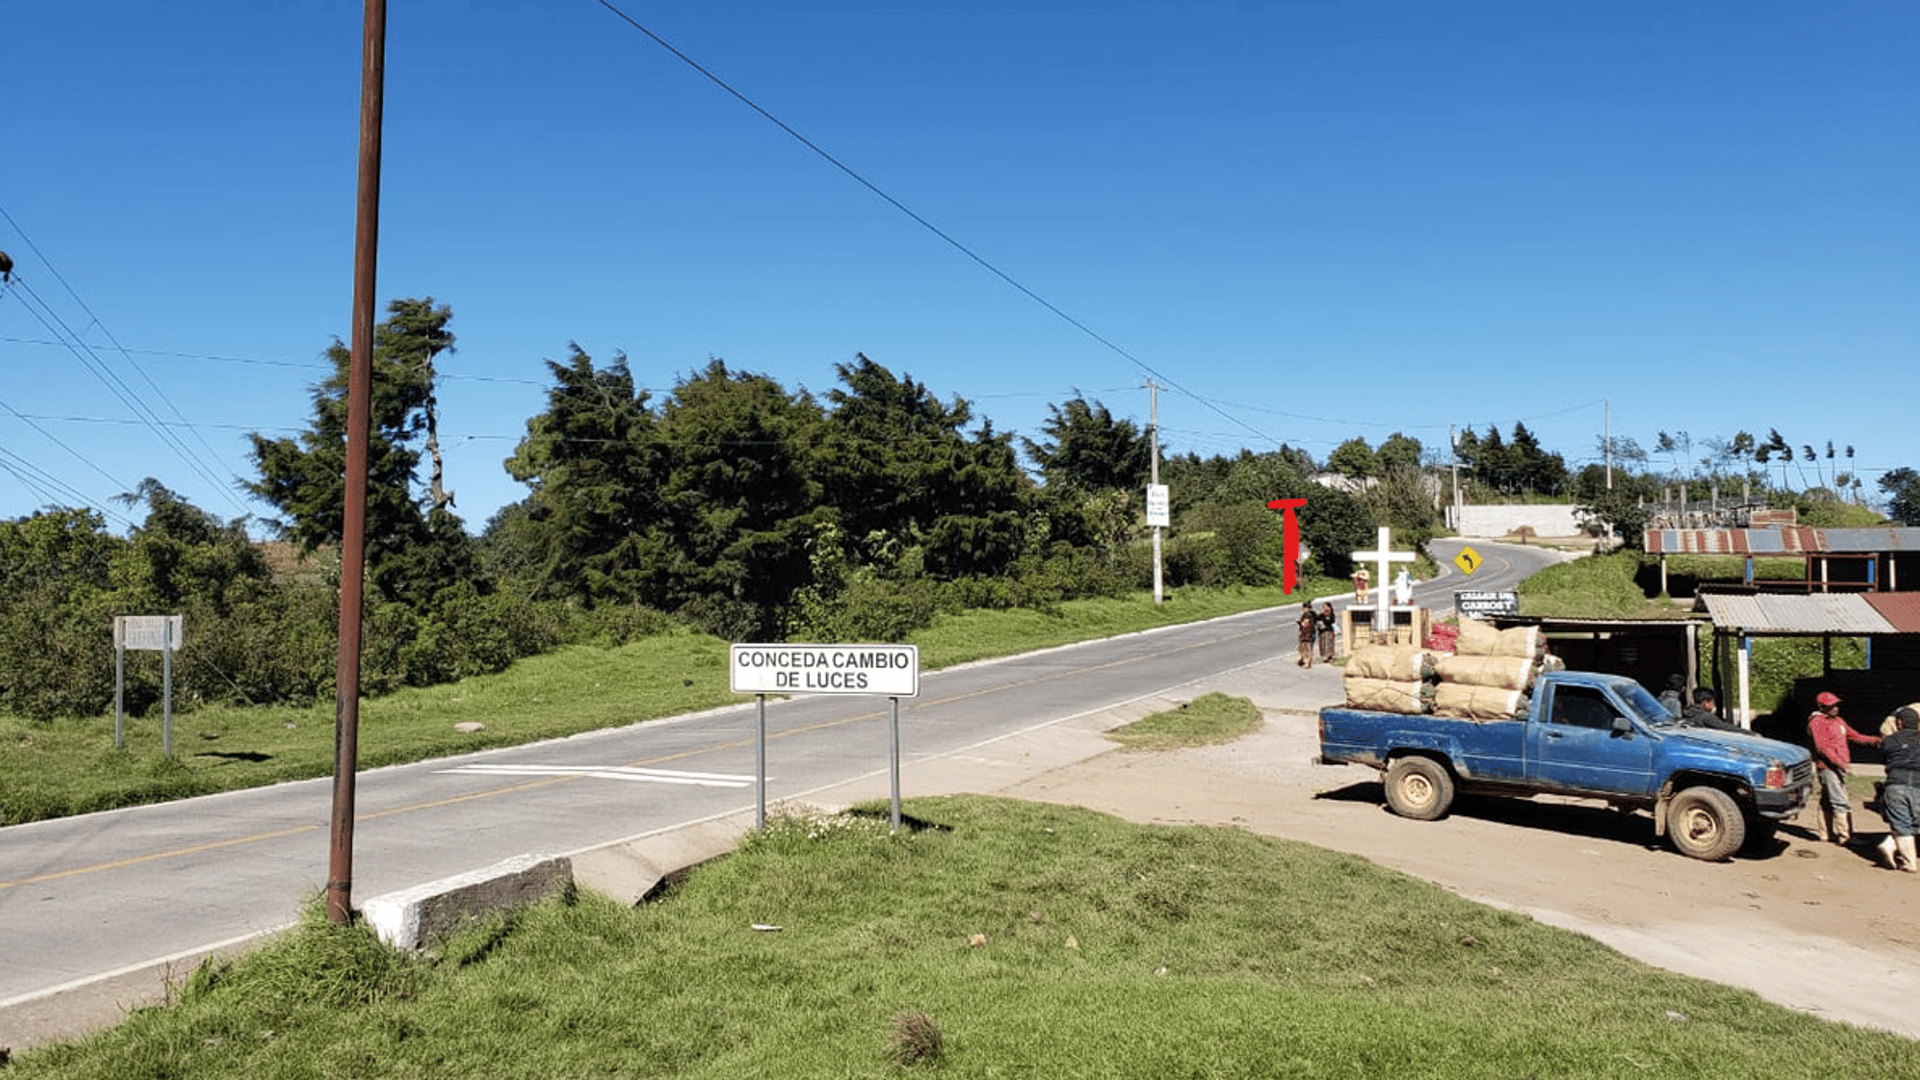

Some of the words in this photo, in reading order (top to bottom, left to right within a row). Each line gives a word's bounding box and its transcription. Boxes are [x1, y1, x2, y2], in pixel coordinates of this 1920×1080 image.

[738, 651, 829, 668] CONCEDA
[832, 652, 909, 669] CAMBIO
[776, 671, 800, 687] DE
[806, 672, 869, 688] LUCES
